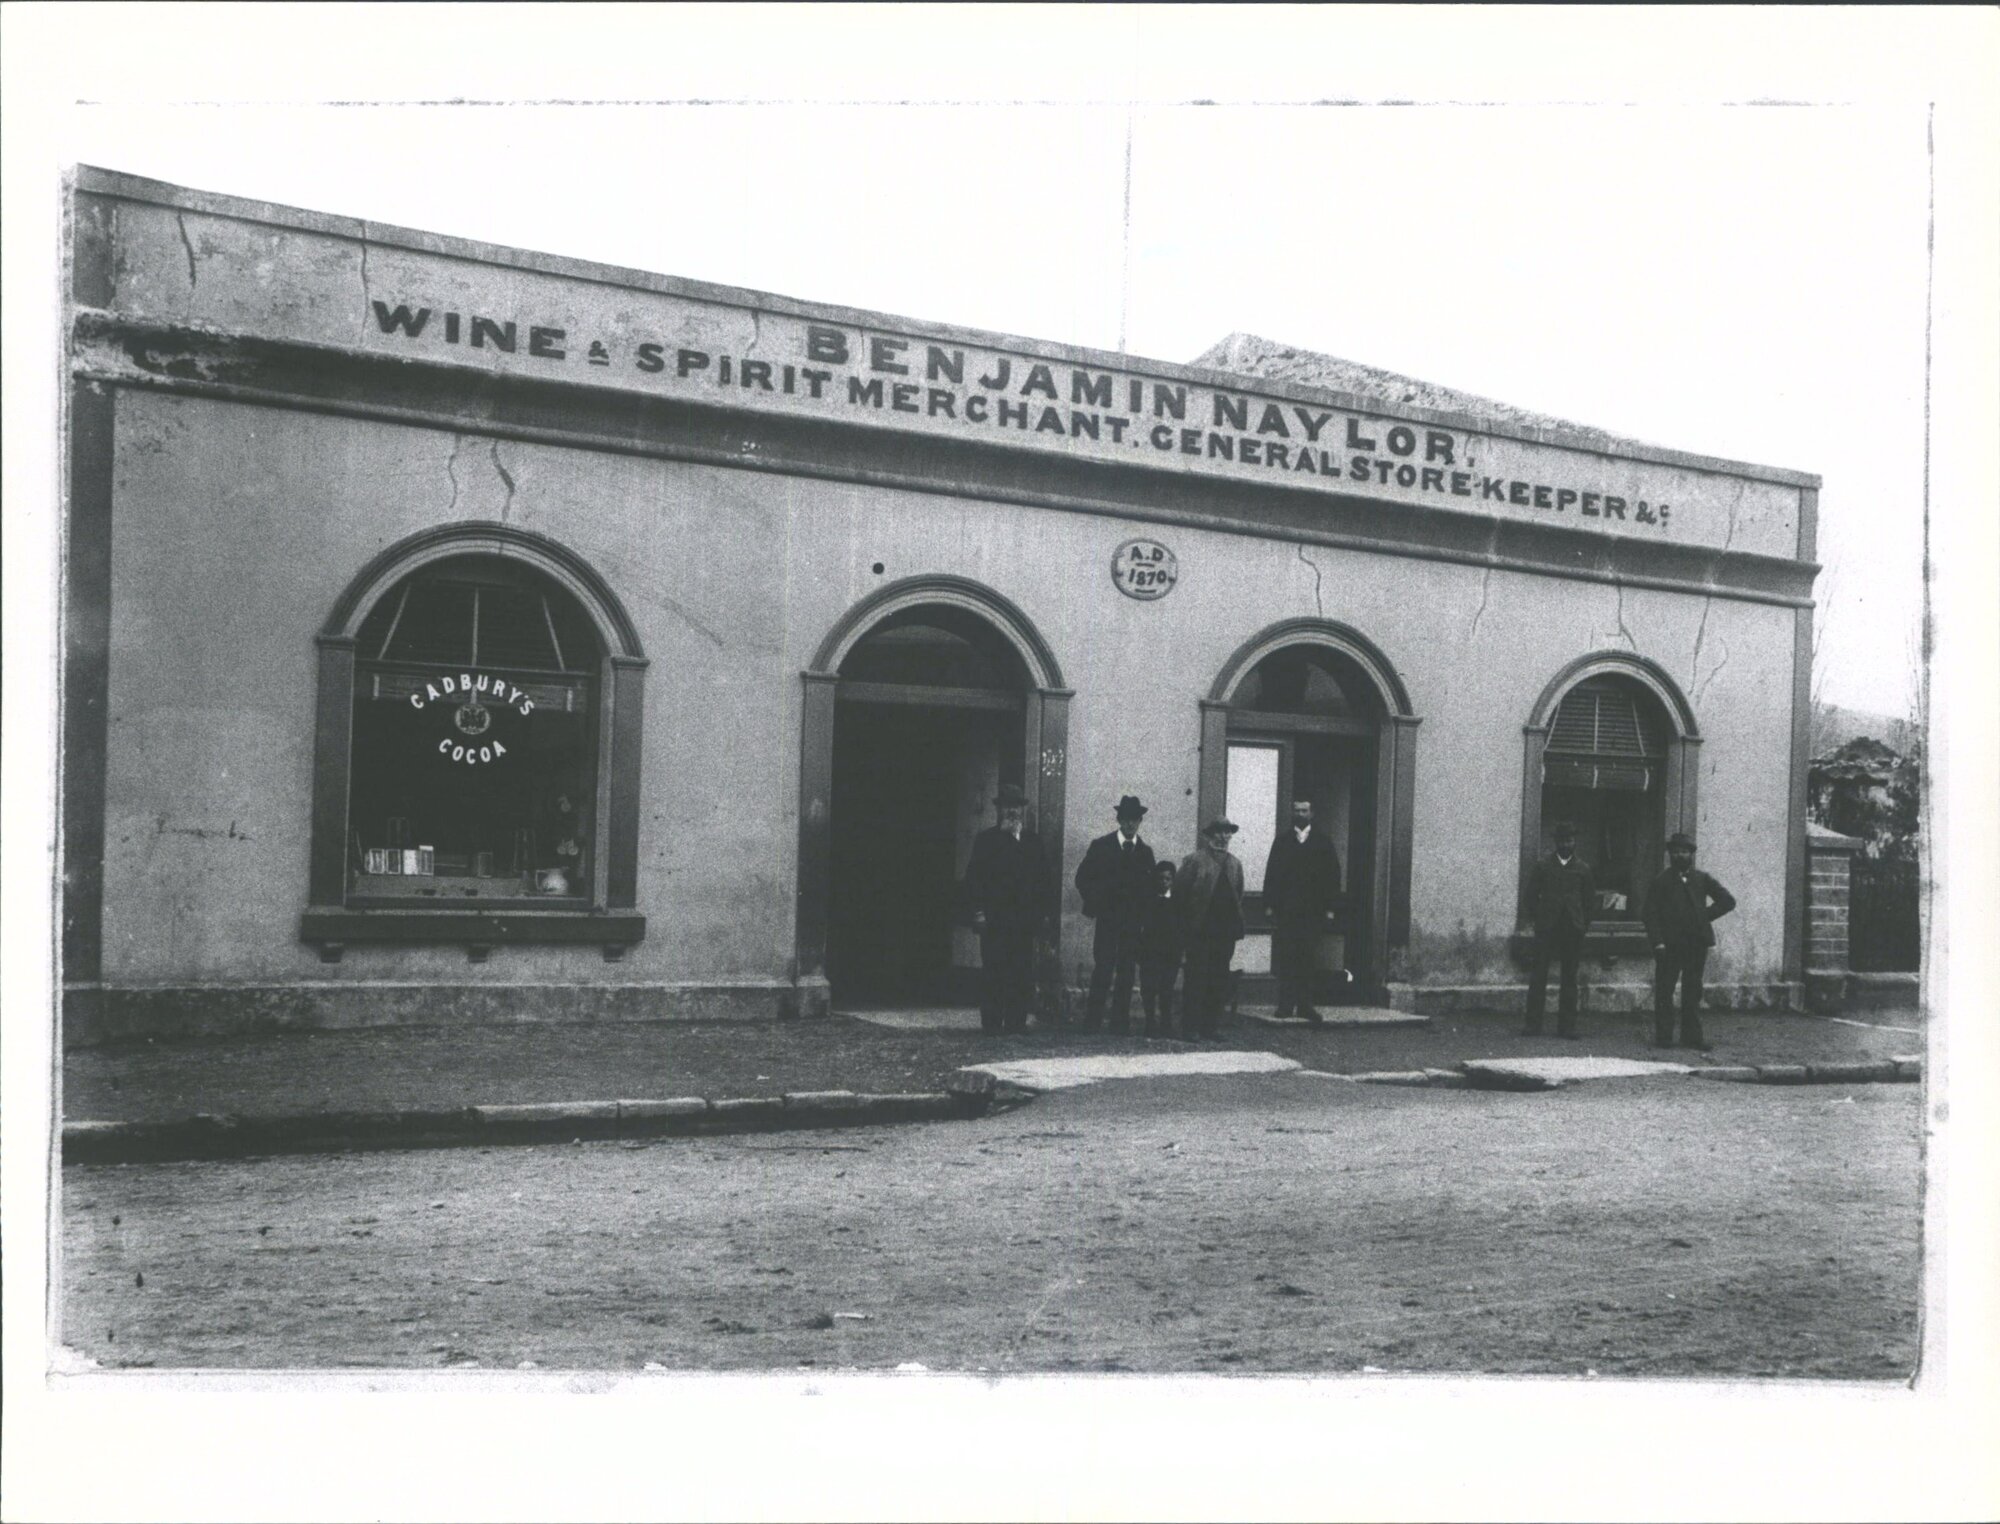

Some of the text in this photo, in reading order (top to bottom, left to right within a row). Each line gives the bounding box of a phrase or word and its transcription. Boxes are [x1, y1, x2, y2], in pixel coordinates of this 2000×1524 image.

[372, 300, 566, 360] WINE
[588, 340, 610, 366] &
[636, 343, 832, 399] SPIRIT
[1150, 425, 1341, 477] GENERAL
[807, 325, 1187, 420] BENJAMIN
[439, 738, 507, 765] COCOA
